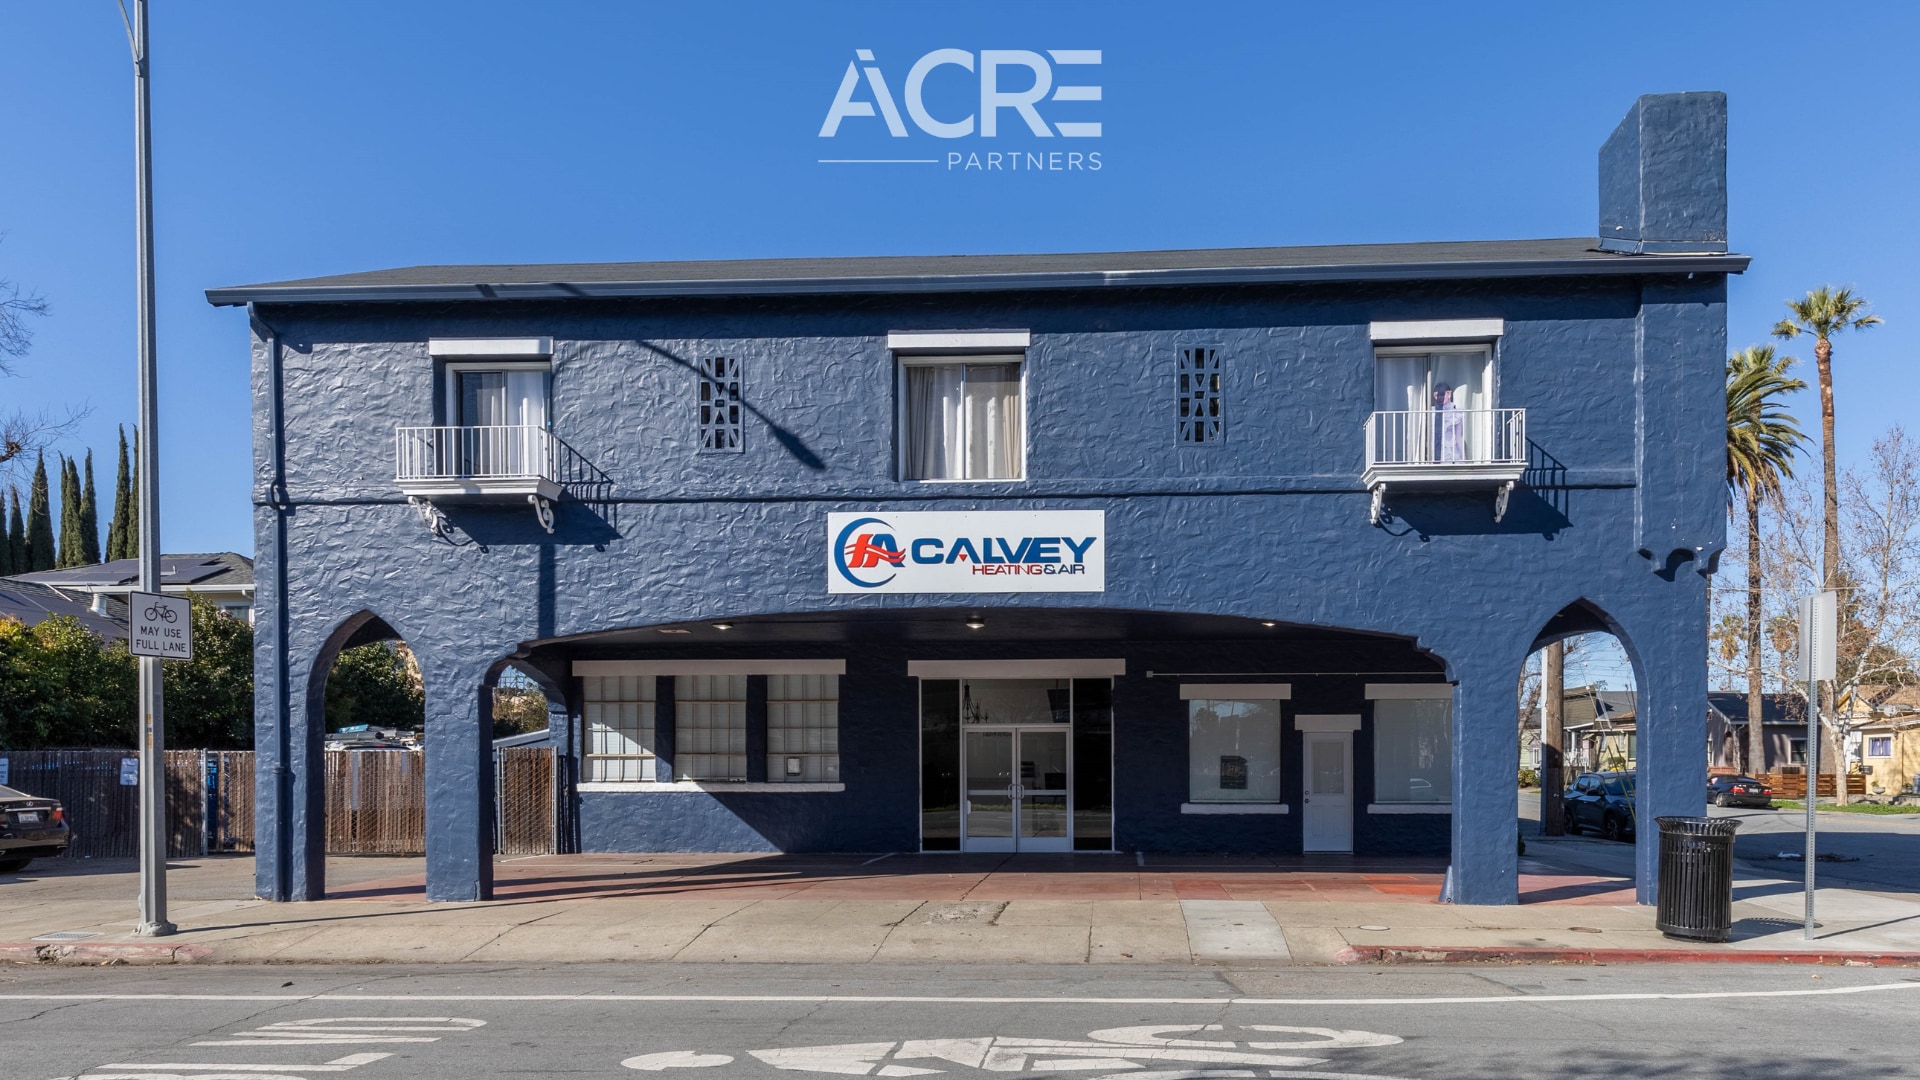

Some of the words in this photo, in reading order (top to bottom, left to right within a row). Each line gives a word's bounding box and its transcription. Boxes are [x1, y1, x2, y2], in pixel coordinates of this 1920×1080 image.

[911, 537, 1097, 564] CALVEY
[140, 625, 160, 637] MAY
[164, 628, 182, 638] USE
[136, 639, 159, 650] FULL
[163, 641, 186, 652] LANE
